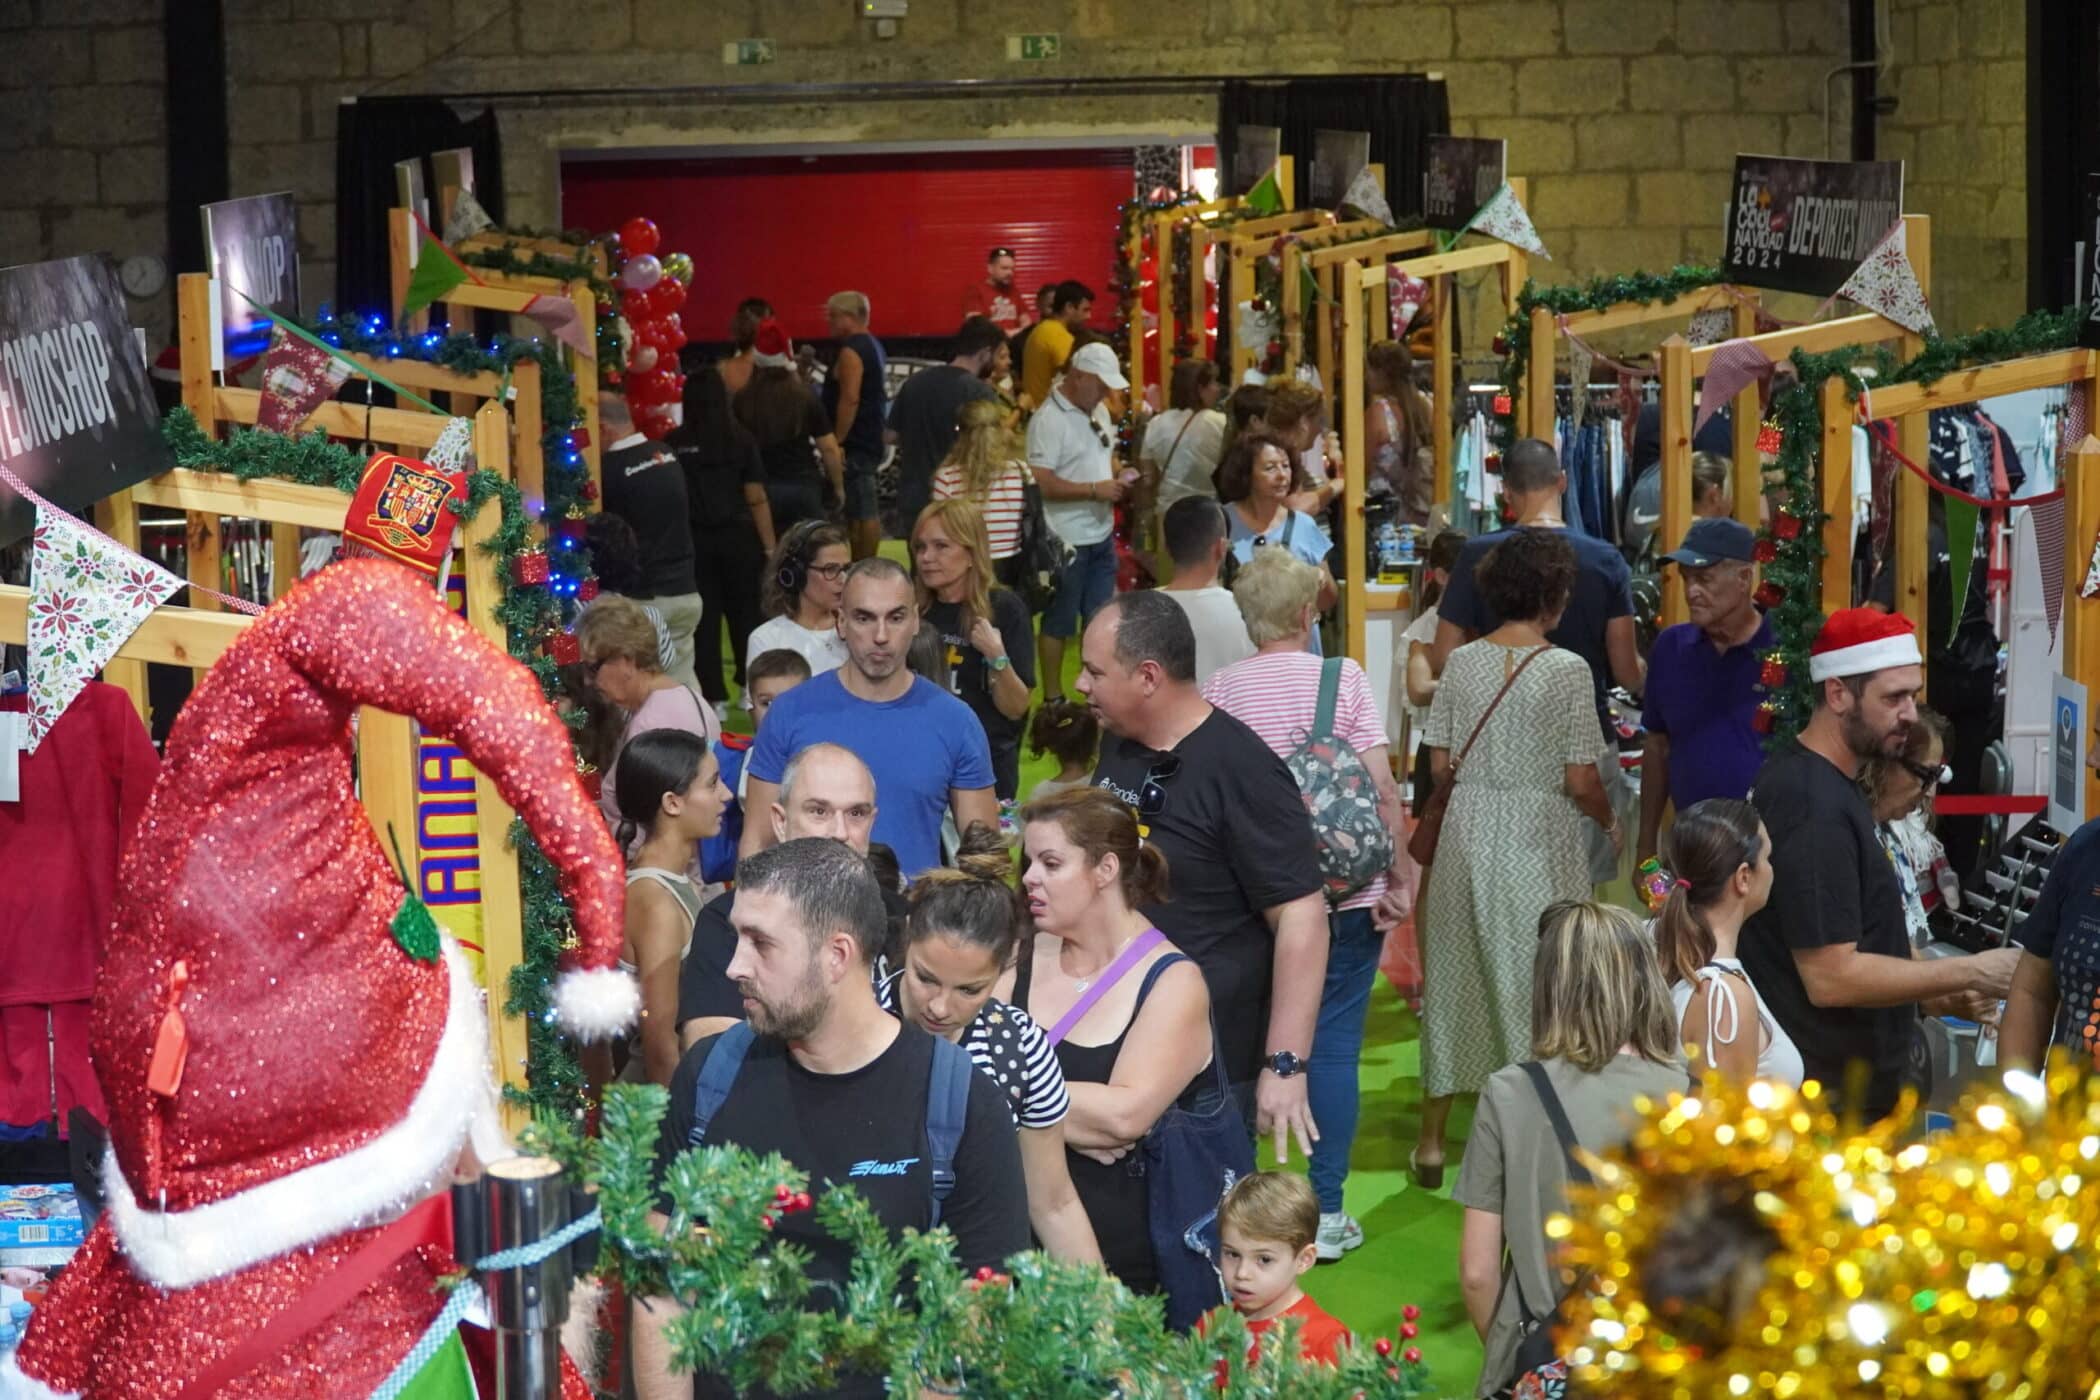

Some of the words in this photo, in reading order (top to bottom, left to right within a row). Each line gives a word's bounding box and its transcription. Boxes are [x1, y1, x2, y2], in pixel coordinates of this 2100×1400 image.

[1734, 228, 1784, 251] NAVIDAD
[1788, 195, 1858, 260] DEPORTES
[1732, 246, 1781, 269] 2024
[0, 320, 117, 461] ECNOSHOP
